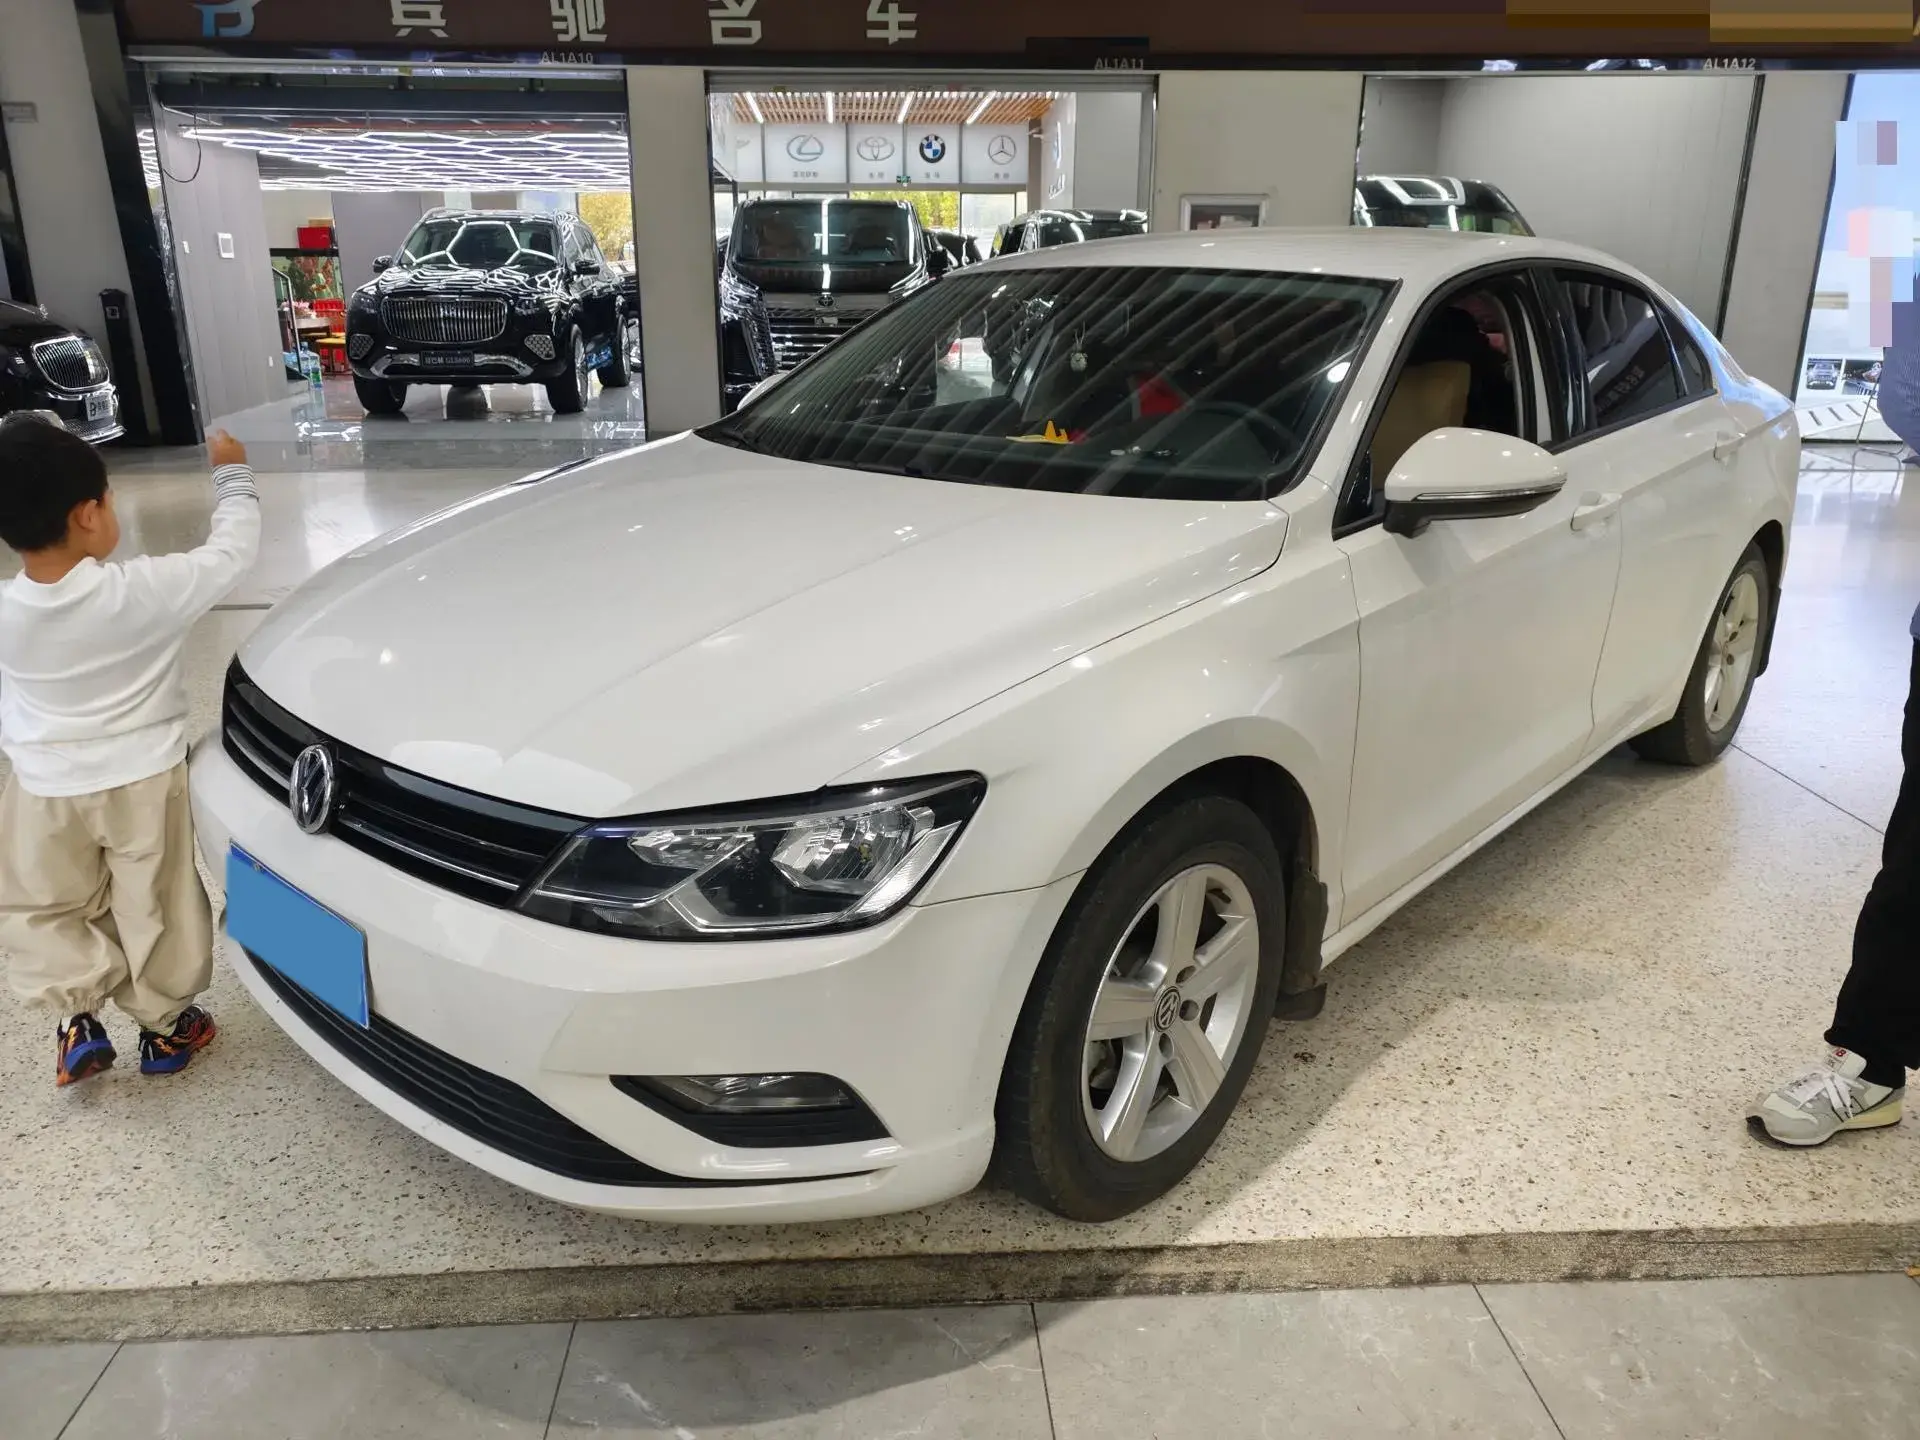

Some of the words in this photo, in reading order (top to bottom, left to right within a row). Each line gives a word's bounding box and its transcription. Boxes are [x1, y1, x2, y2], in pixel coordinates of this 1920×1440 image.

[541, 51, 594, 64] AL1A10
[1094, 57, 1144, 70] AL1A11
[1703, 57, 1756, 70] AL1A12
